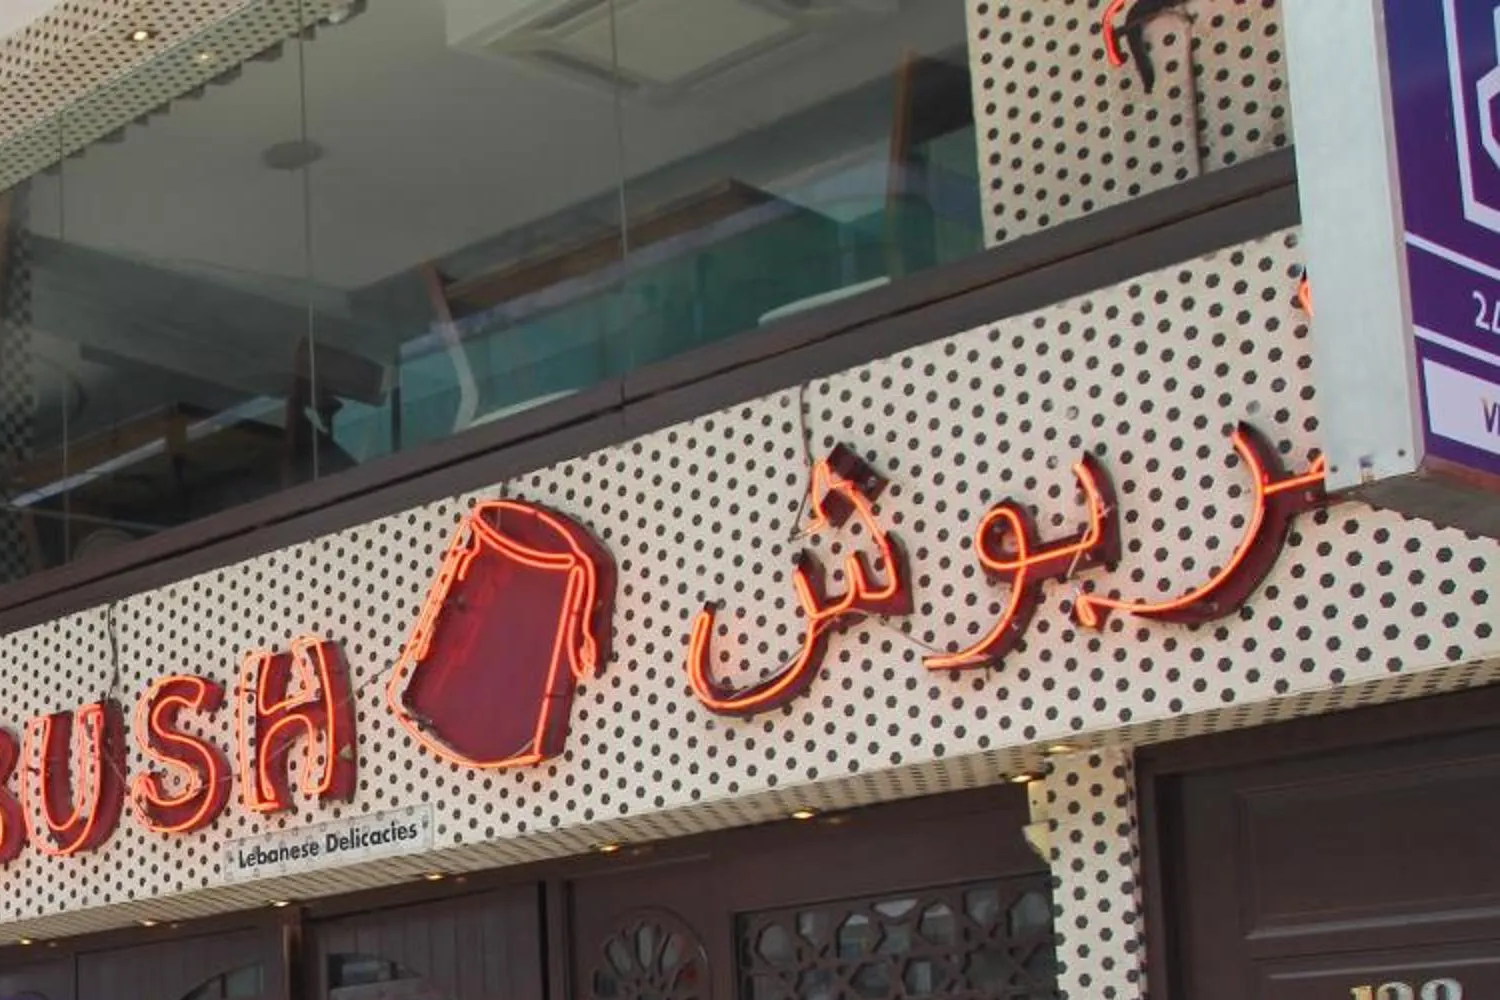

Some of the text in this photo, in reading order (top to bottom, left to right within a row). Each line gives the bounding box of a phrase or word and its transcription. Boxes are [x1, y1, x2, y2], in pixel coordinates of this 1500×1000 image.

[686, 420, 1325, 716] ربوش
[238, 822, 418, 870] Lebanese Delicacies
